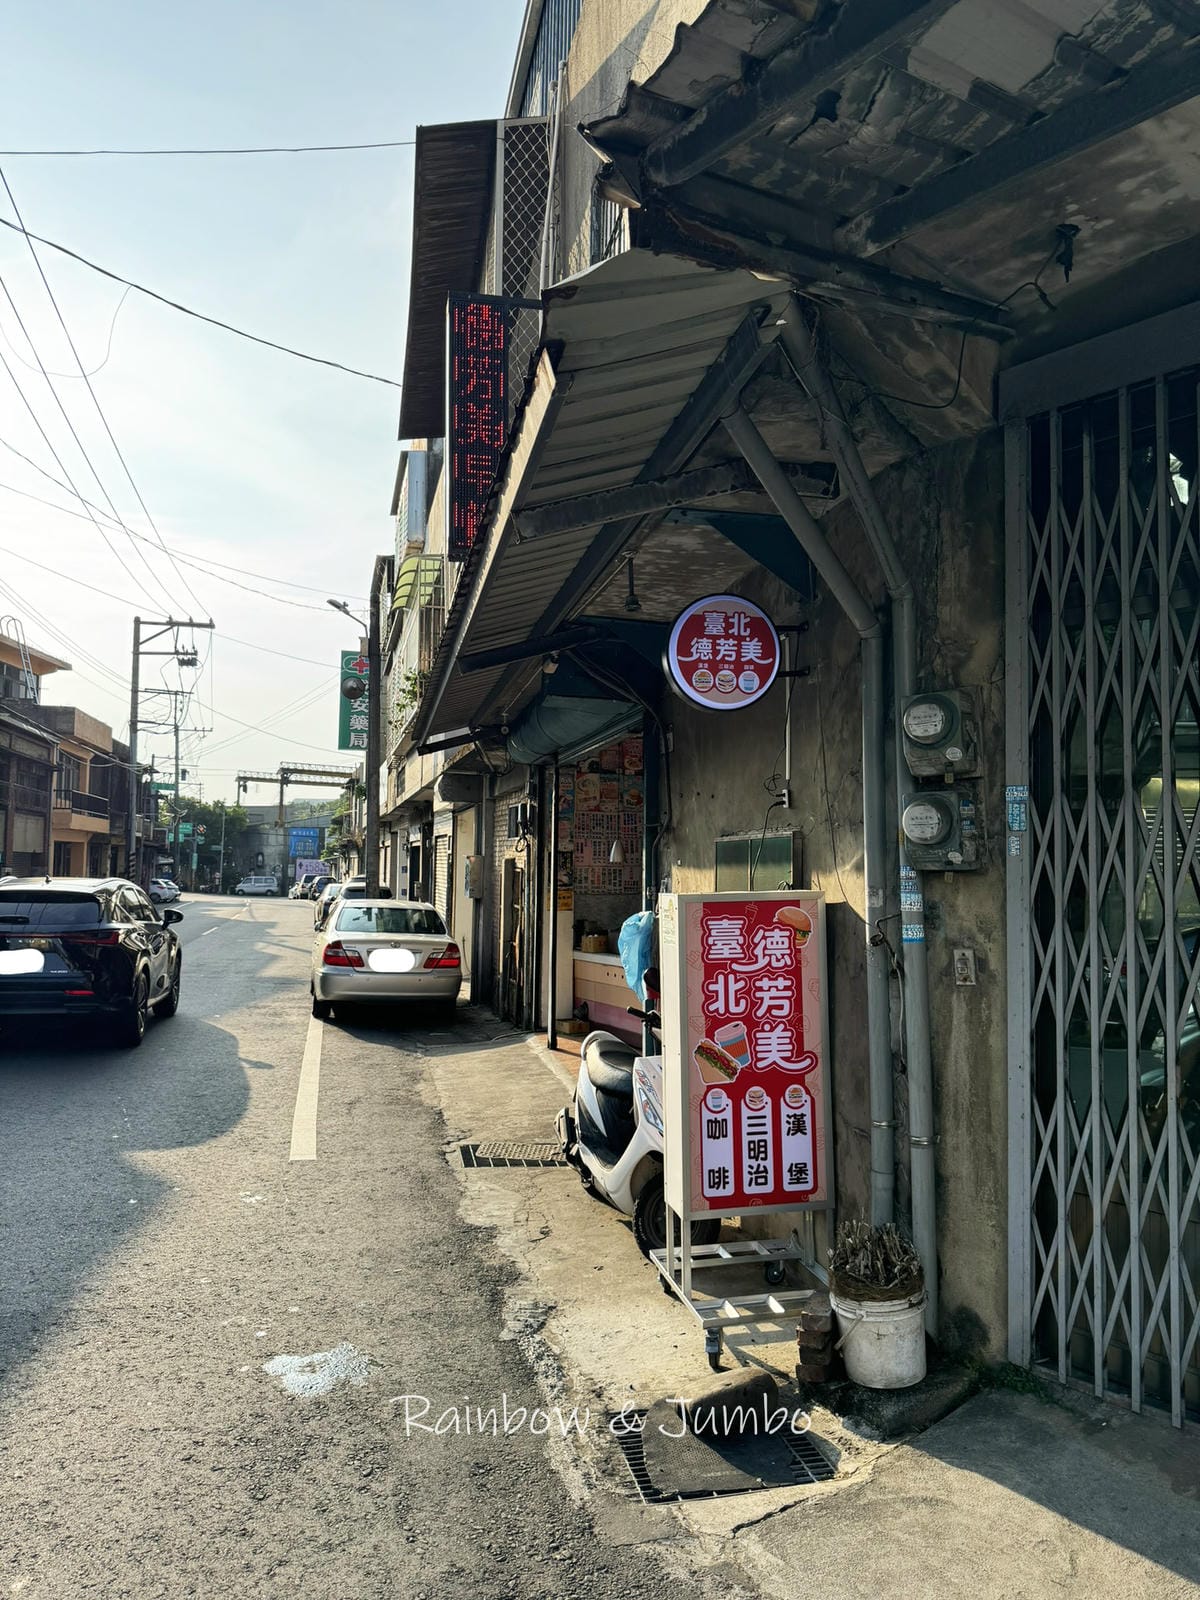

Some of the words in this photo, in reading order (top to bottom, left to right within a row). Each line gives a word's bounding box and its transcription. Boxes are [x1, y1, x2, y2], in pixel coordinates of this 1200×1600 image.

[677, 637, 773, 664] 德芳美
[704, 612, 750, 635] 臺北
[349, 679, 369, 748] 安藥局
[707, 918, 748, 1015] 臺北
[731, 928, 812, 1071] 德芳美
[706, 1117, 730, 1191] 咖啡
[746, 1115, 769, 1188] 三明治
[786, 1113, 809, 1186] 漢堡
